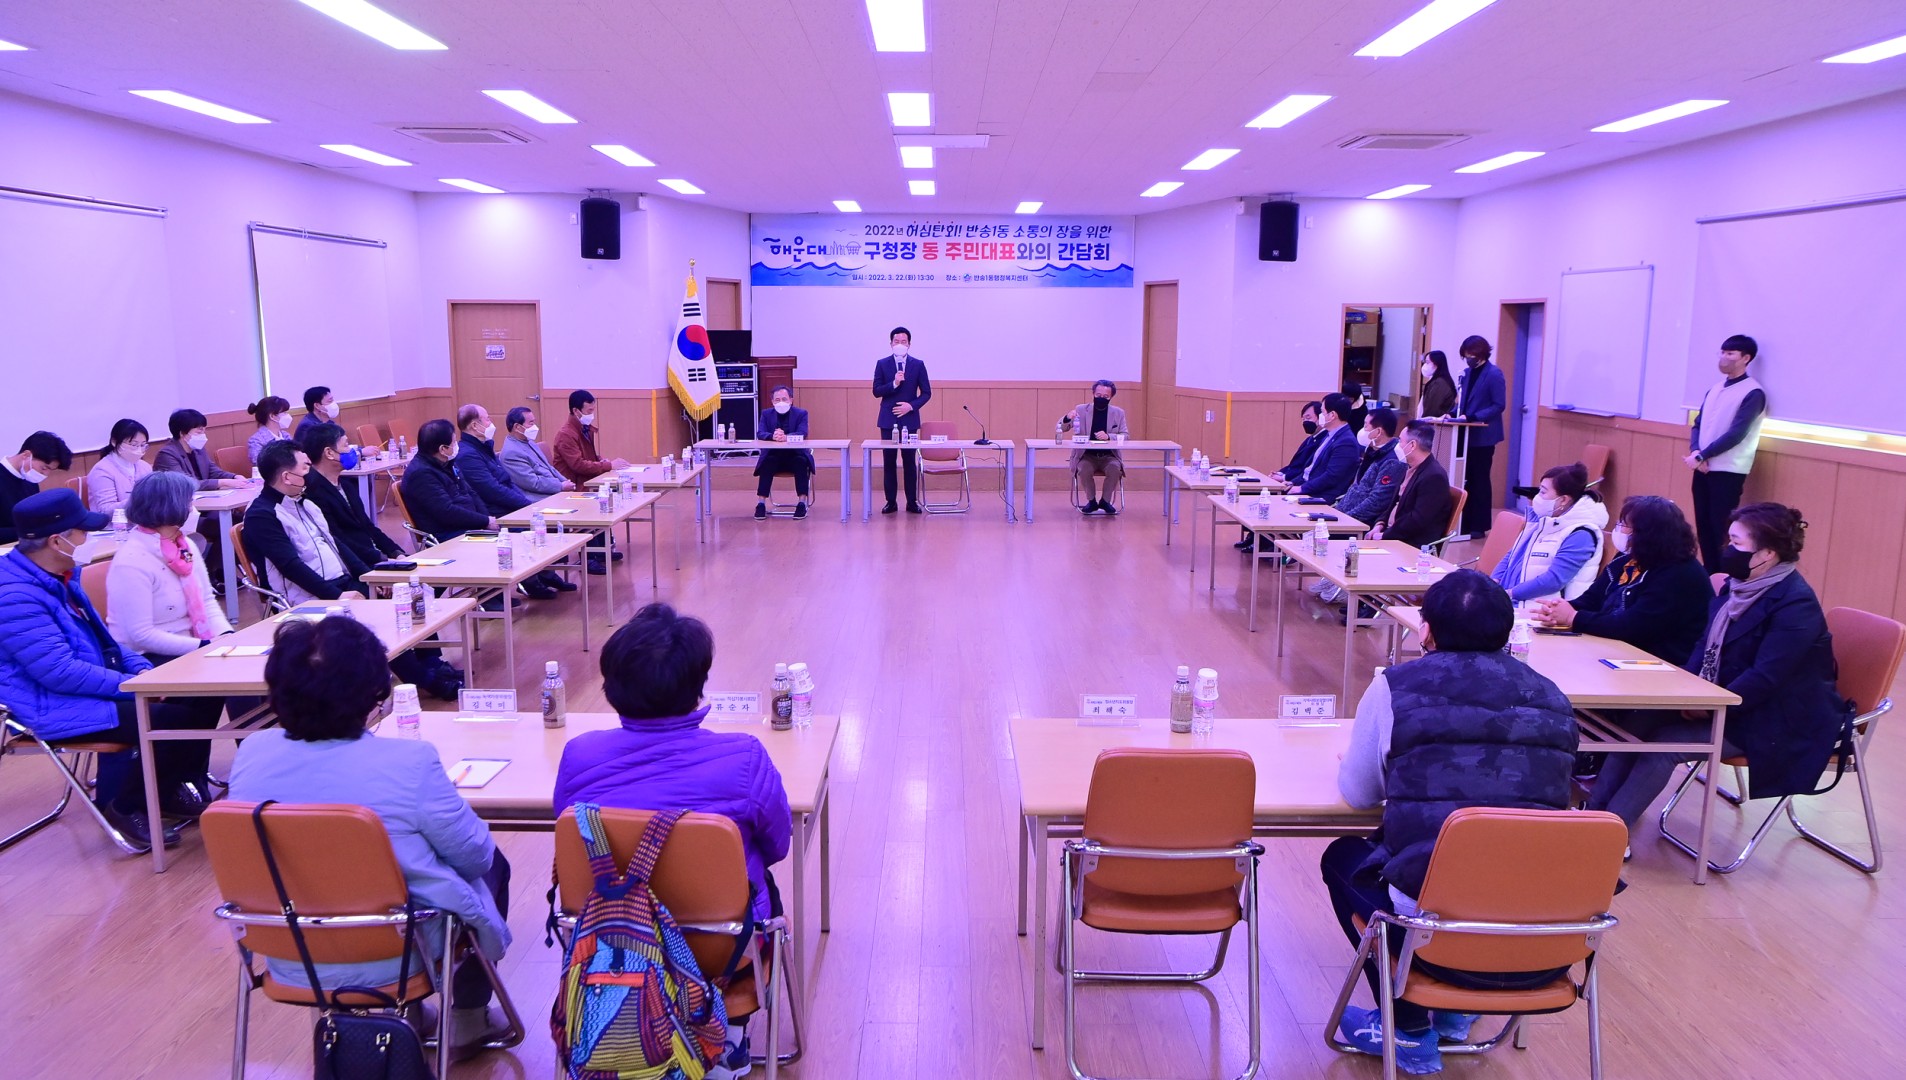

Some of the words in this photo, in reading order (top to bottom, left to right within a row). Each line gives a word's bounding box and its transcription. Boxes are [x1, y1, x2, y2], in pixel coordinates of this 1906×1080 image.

[864, 224, 904, 236] 2022년
[966, 224, 1009, 239] 반송1동
[1013, 225, 1053, 239] 소통의
[1056, 225, 1082, 239] 장을
[1086, 225, 1112, 239] 위한
[763, 236, 827, 262] 해운대
[864, 242, 917, 260] 구청장
[922, 242, 939, 260] 동
[945, 242, 1051, 261] 주민대표와의
[1058, 243, 1110, 261] 간담회
